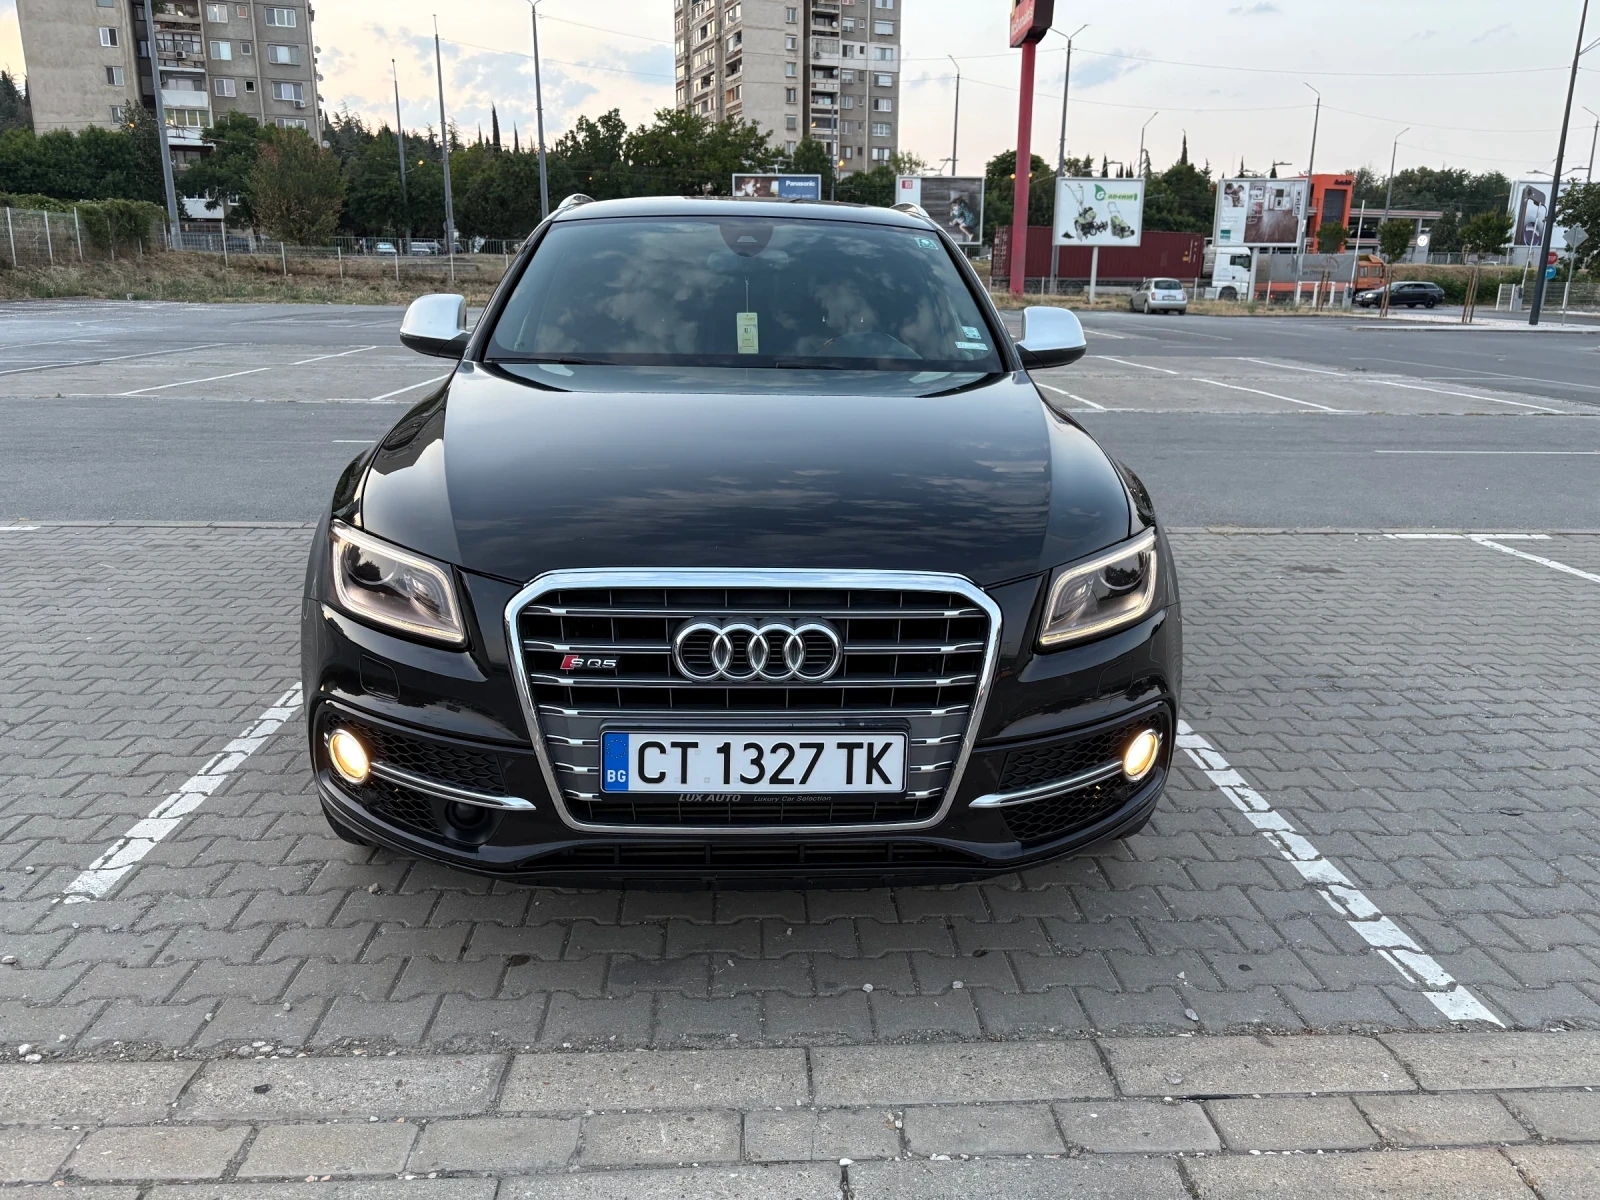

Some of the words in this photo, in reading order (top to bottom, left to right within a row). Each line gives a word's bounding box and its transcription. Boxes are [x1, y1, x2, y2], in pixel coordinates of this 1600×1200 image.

[638, 741, 699, 784] CT
[717, 742, 825, 784] 1327
[836, 742, 893, 784] TK
[607, 769, 627, 782] BG
[679, 794, 703, 802] LUX
[706, 794, 741, 802] AUTO
